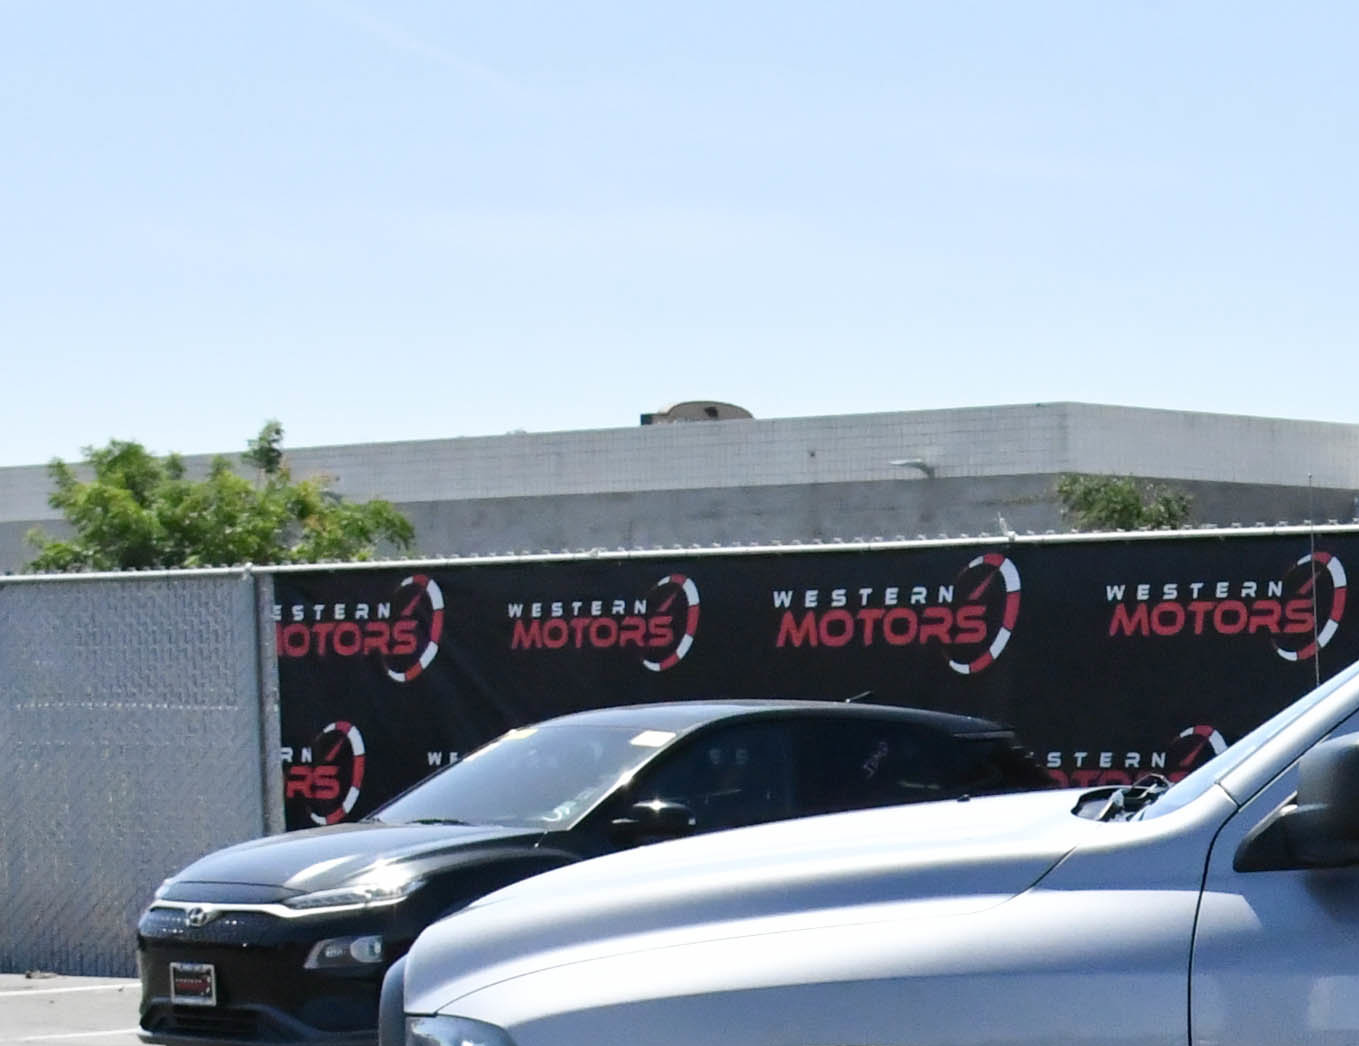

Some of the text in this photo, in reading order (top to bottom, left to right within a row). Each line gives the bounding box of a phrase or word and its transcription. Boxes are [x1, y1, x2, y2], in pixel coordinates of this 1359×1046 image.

[773, 586, 954, 608] WESTERN
[1106, 581, 1282, 600] WESTERN
[272, 603, 391, 620] ESTERN
[508, 600, 648, 617] WESTERN
[1109, 599, 1316, 637] MOTORS
[511, 616, 673, 649] MOTORS
[776, 605, 986, 647] MOTORS
[1046, 752, 1166, 768] STERN
